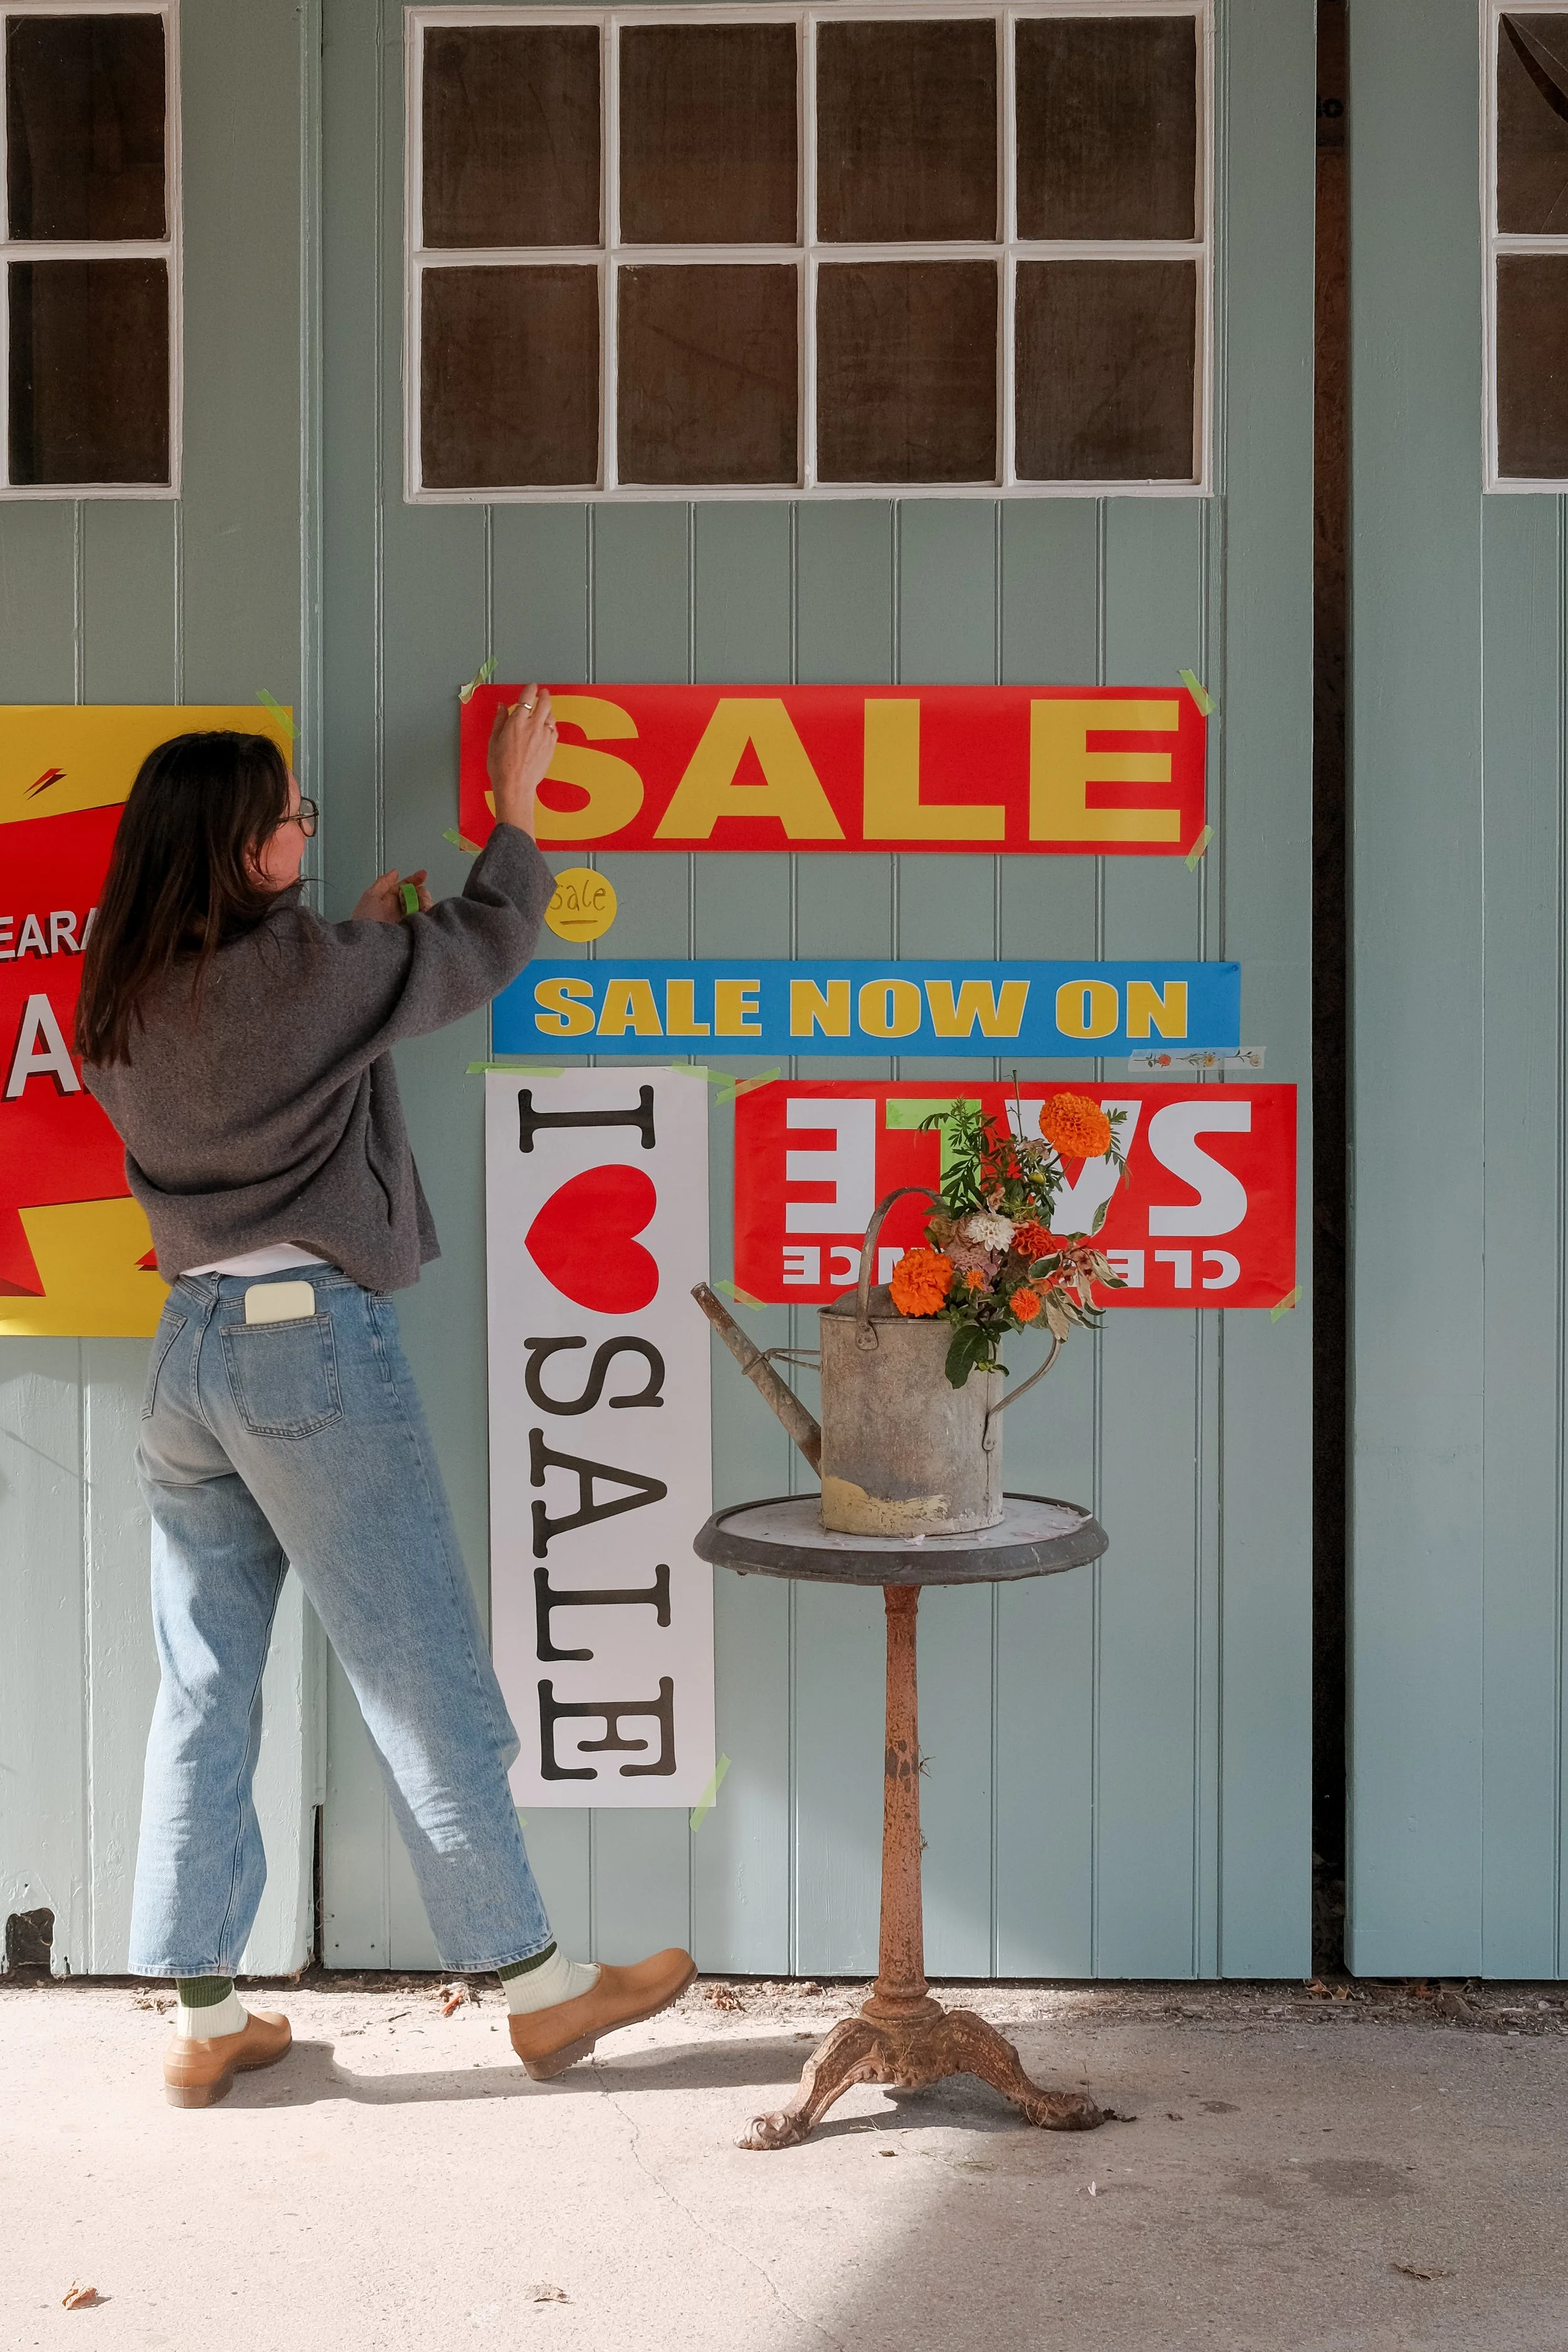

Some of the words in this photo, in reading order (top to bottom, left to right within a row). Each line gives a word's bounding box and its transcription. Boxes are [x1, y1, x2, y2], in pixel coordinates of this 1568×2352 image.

[484, 695, 1181, 842] SALE
[550, 879, 607, 911] sale
[534, 977, 763, 1037] SALE
[789, 978, 1030, 1038] NOW
[1055, 980, 1189, 1039] ON
[517, 1084, 656, 1154] I
[782, 1245, 1241, 1290] CLECE
[523, 1335, 678, 1781] SALE
